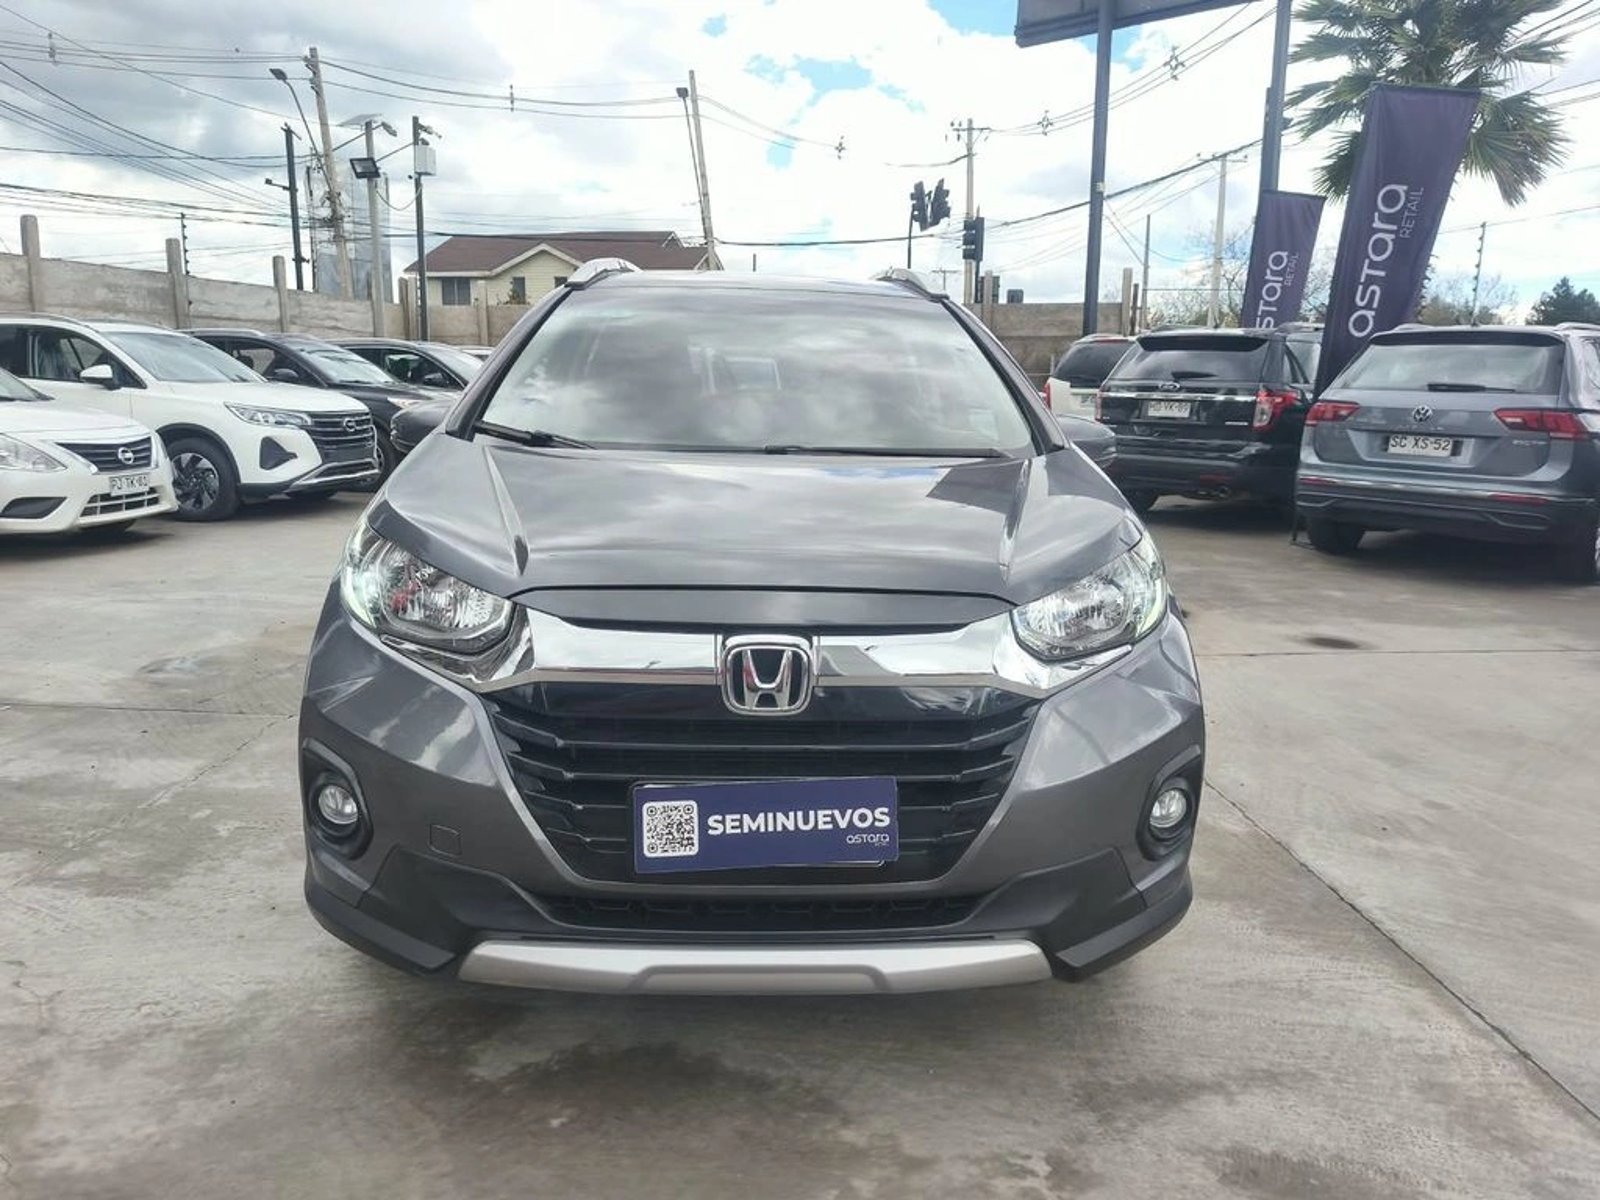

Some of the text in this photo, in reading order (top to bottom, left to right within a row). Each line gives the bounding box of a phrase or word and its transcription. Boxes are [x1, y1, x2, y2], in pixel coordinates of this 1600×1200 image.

[1400, 186, 1424, 238] RETAIL
[1284, 252, 1299, 287] RETAIL
[1348, 184, 1408, 338] astara
[1256, 251, 1289, 329] stara
[1390, 435, 1408, 448] SC
[707, 806, 891, 836] SEMINUEVOS
[846, 833, 890, 845] astara
